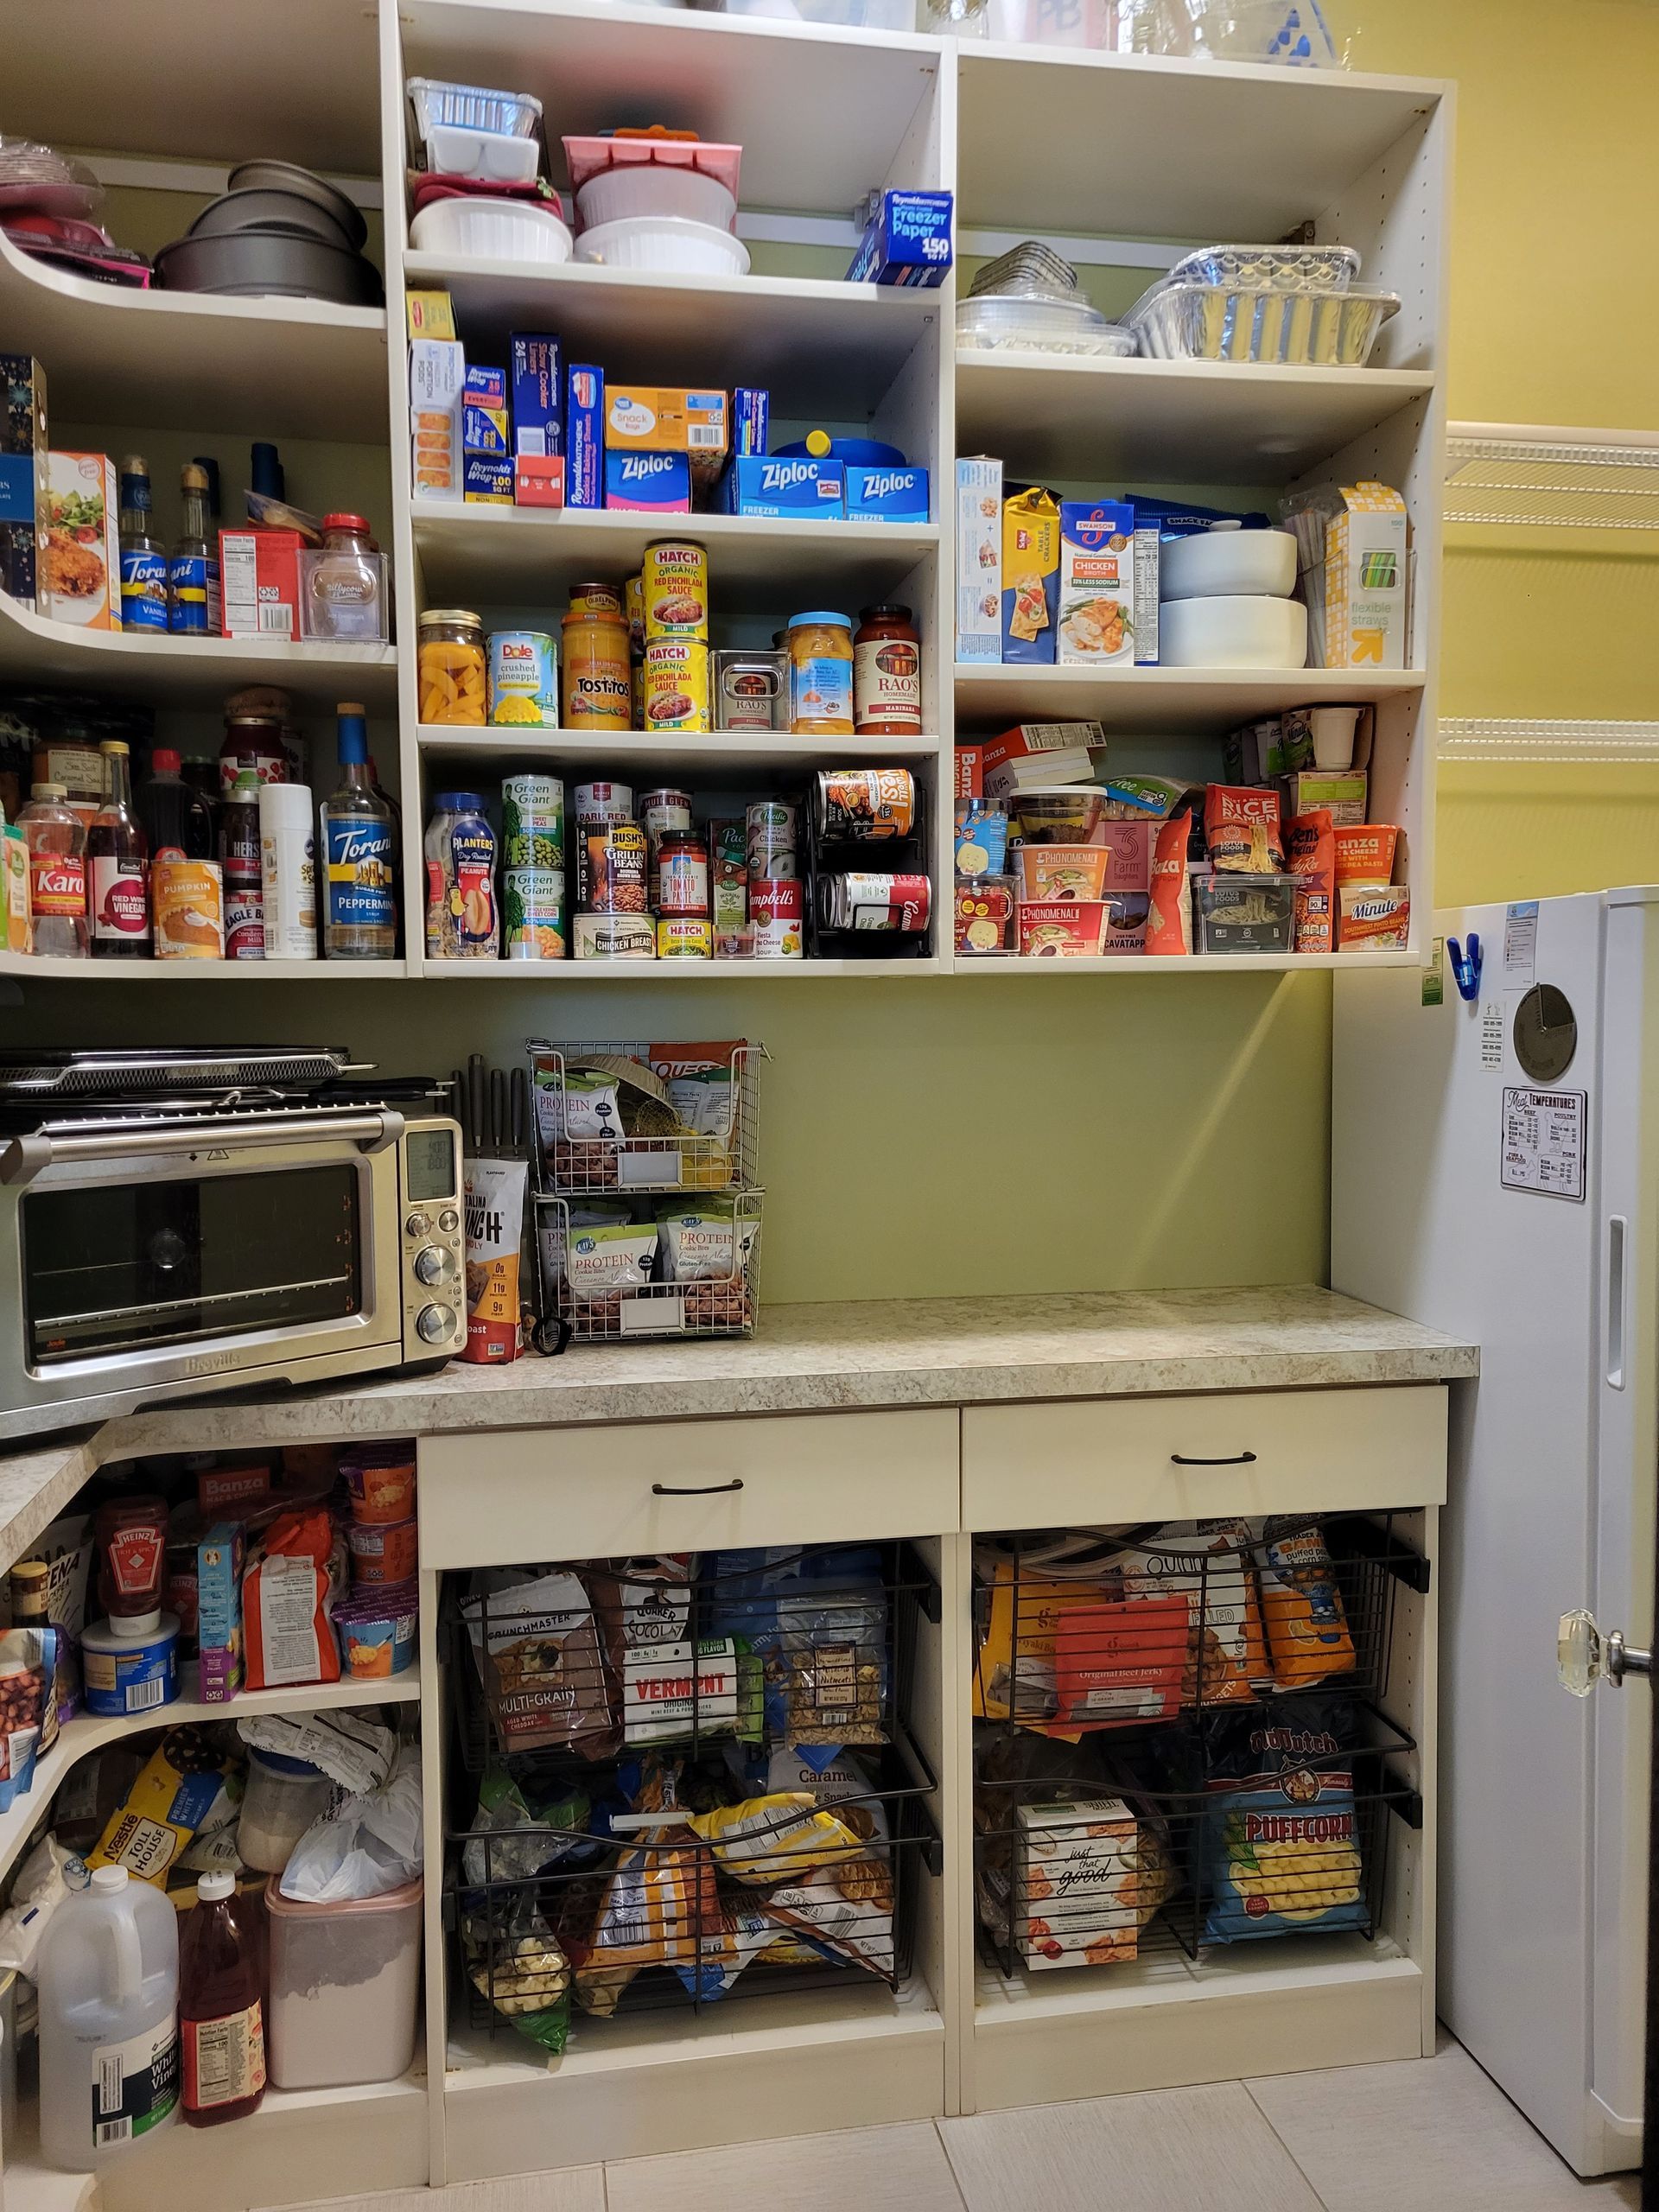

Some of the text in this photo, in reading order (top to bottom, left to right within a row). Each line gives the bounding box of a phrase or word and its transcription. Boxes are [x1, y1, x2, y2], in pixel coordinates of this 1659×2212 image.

[893, 207, 947, 226] Freezer
[893, 221, 935, 242] Paper
[922, 238, 949, 254] 150
[515, 340, 526, 358] 24
[538, 342, 549, 410] Slow Cooker
[617, 414, 647, 423] Snack
[583, 442, 592, 471] Baking
[471, 461, 511, 474] Reynolds
[621, 454, 674, 480] Ziploc
[467, 470, 492, 483] Wrap
[492, 477, 512, 487] 100
[762, 461, 819, 490] Ziploc
[863, 474, 914, 499] Ziploc
[742, 505, 779, 516] FREEZER
[658, 550, 698, 563] HATCH
[658, 566, 698, 577] ORGANIC
[1074, 562, 1116, 571] CHICKEN
[654, 577, 703, 588] RED ENCHILADA
[667, 585, 692, 595] SAUCE
[1351, 601, 1392, 613] flexible
[1351, 615, 1389, 626] straws
[502, 644, 533, 659] Dole
[649, 647, 686, 662] HATCH
[500, 664, 536, 672] crushed
[649, 662, 685, 673] ORGANIC
[498, 672, 540, 683] pineapple
[655, 674, 692, 683] ENCHILADA
[577, 677, 629, 697] TOSTITOS
[654, 682, 678, 692] SAUCE
[878, 677, 918, 693] RAO'S
[736, 701, 766, 711] RAO'S
[514, 783, 550, 794] Green
[518, 795, 550, 804] Giant
[645, 797, 690, 808] MUIR GLEN
[1222, 797, 1277, 817] RICE
[763, 810, 786, 822] Pacific
[1223, 808, 1278, 826] RAMEN
[452, 836, 494, 851] PLANTERS
[612, 833, 643, 845] BUSH'S
[759, 835, 788, 844] Chicken
[1114, 827, 1139, 861] 3
[457, 852, 471, 861] Dry
[604, 847, 645, 861] GRILLIN'
[613, 859, 644, 869] BEANS
[1114, 860, 1139, 873] Farm
[37, 870, 85, 893] Karo
[518, 874, 553, 885] Green
[669, 879, 695, 891] TOMATO
[163, 881, 211, 895] PUMPKIN
[522, 885, 554, 895] Giant
[672, 891, 692, 904] PASTE
[1351, 899, 1399, 921] Minute
[226, 908, 252, 931] EAGLE
[1344, 916, 1406, 934] SOUTHWEST PINTO BEANS
[670, 925, 702, 935] HATCH
[597, 938, 652, 952] CHICKEN BREAST
[539, 1096, 590, 1112] PROTEIN
[1506, 1090, 1576, 1113] Meat TEMPERATURES
[679, 1232, 734, 1245] PROTEIN
[575, 1253, 634, 1269] PROTEIN
[495, 1262, 505, 1274] 0g
[493, 1282, 505, 1294] 11g
[492, 1302, 503, 1314] 9g
[185, 1352, 241, 1375] Breville
[205, 1478, 264, 1496] Banza
[122, 1531, 150, 1543] HEINZ
[1286, 1548, 1313, 1560] puffed
[703, 1644, 725, 1654] FLAVOR
[1079, 1669, 1119, 1680] Original
[1139, 1668, 1163, 1677] Jerky
[499, 1686, 576, 1715] MULTI-GRAIN
[505, 1713, 539, 1726] AGED WHITE
[510, 1720, 535, 1731] CHEDDAR
[799, 1769, 858, 1783] Caramel
[171, 1787, 190, 1820] PREMIER
[179, 1796, 195, 1821] WHITE
[1245, 1811, 1353, 1844] PUFFCORN
[128, 1829, 153, 1859] TOLL
[135, 1828, 166, 1872] HOUSE
[1064, 1847, 1095, 1864] just
[1079, 1858, 1101, 1871] that
[1056, 1858, 1113, 1896] good
